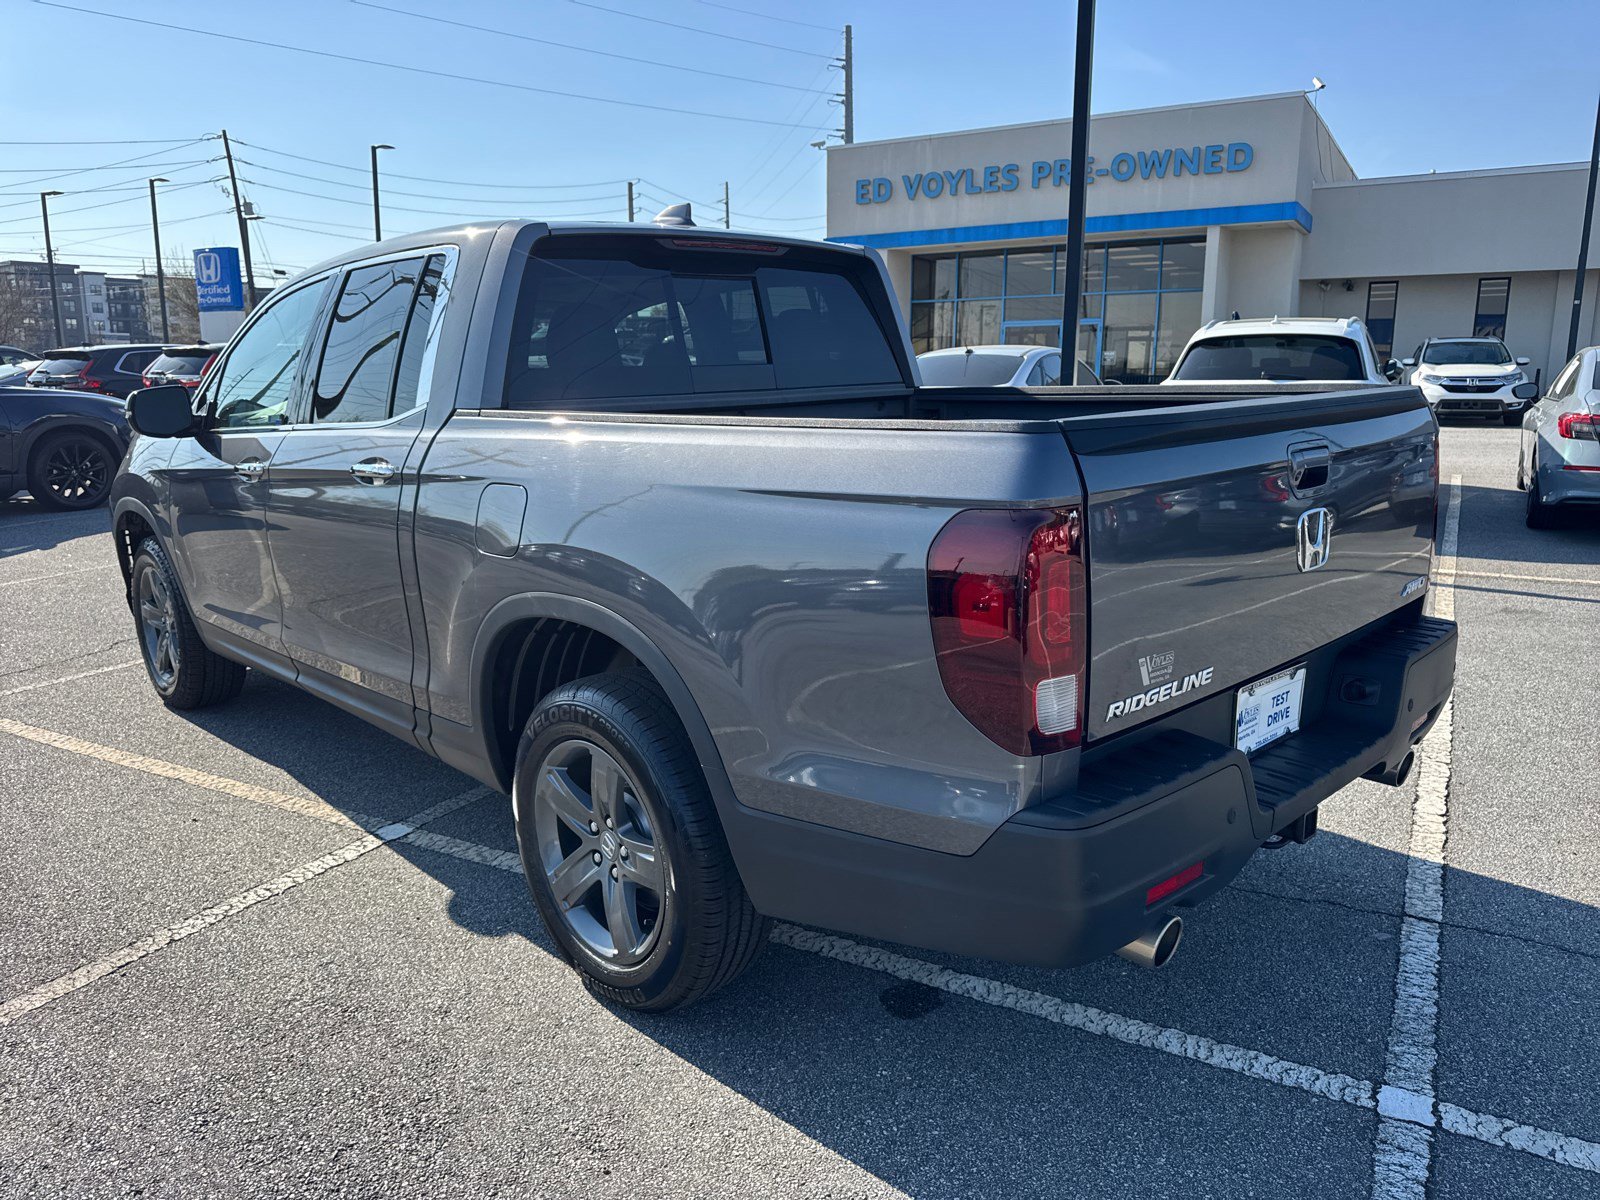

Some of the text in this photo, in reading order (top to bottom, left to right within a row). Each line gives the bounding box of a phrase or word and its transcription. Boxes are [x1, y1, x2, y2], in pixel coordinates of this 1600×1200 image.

[856, 178, 893, 205] ED
[902, 163, 1019, 201] VOYLES
[1105, 667, 1214, 723] RIDGELINE
[1271, 690, 1290, 708] TEST
[527, 704, 599, 741] VELOCITY
[1267, 706, 1290, 727] DRIVE
